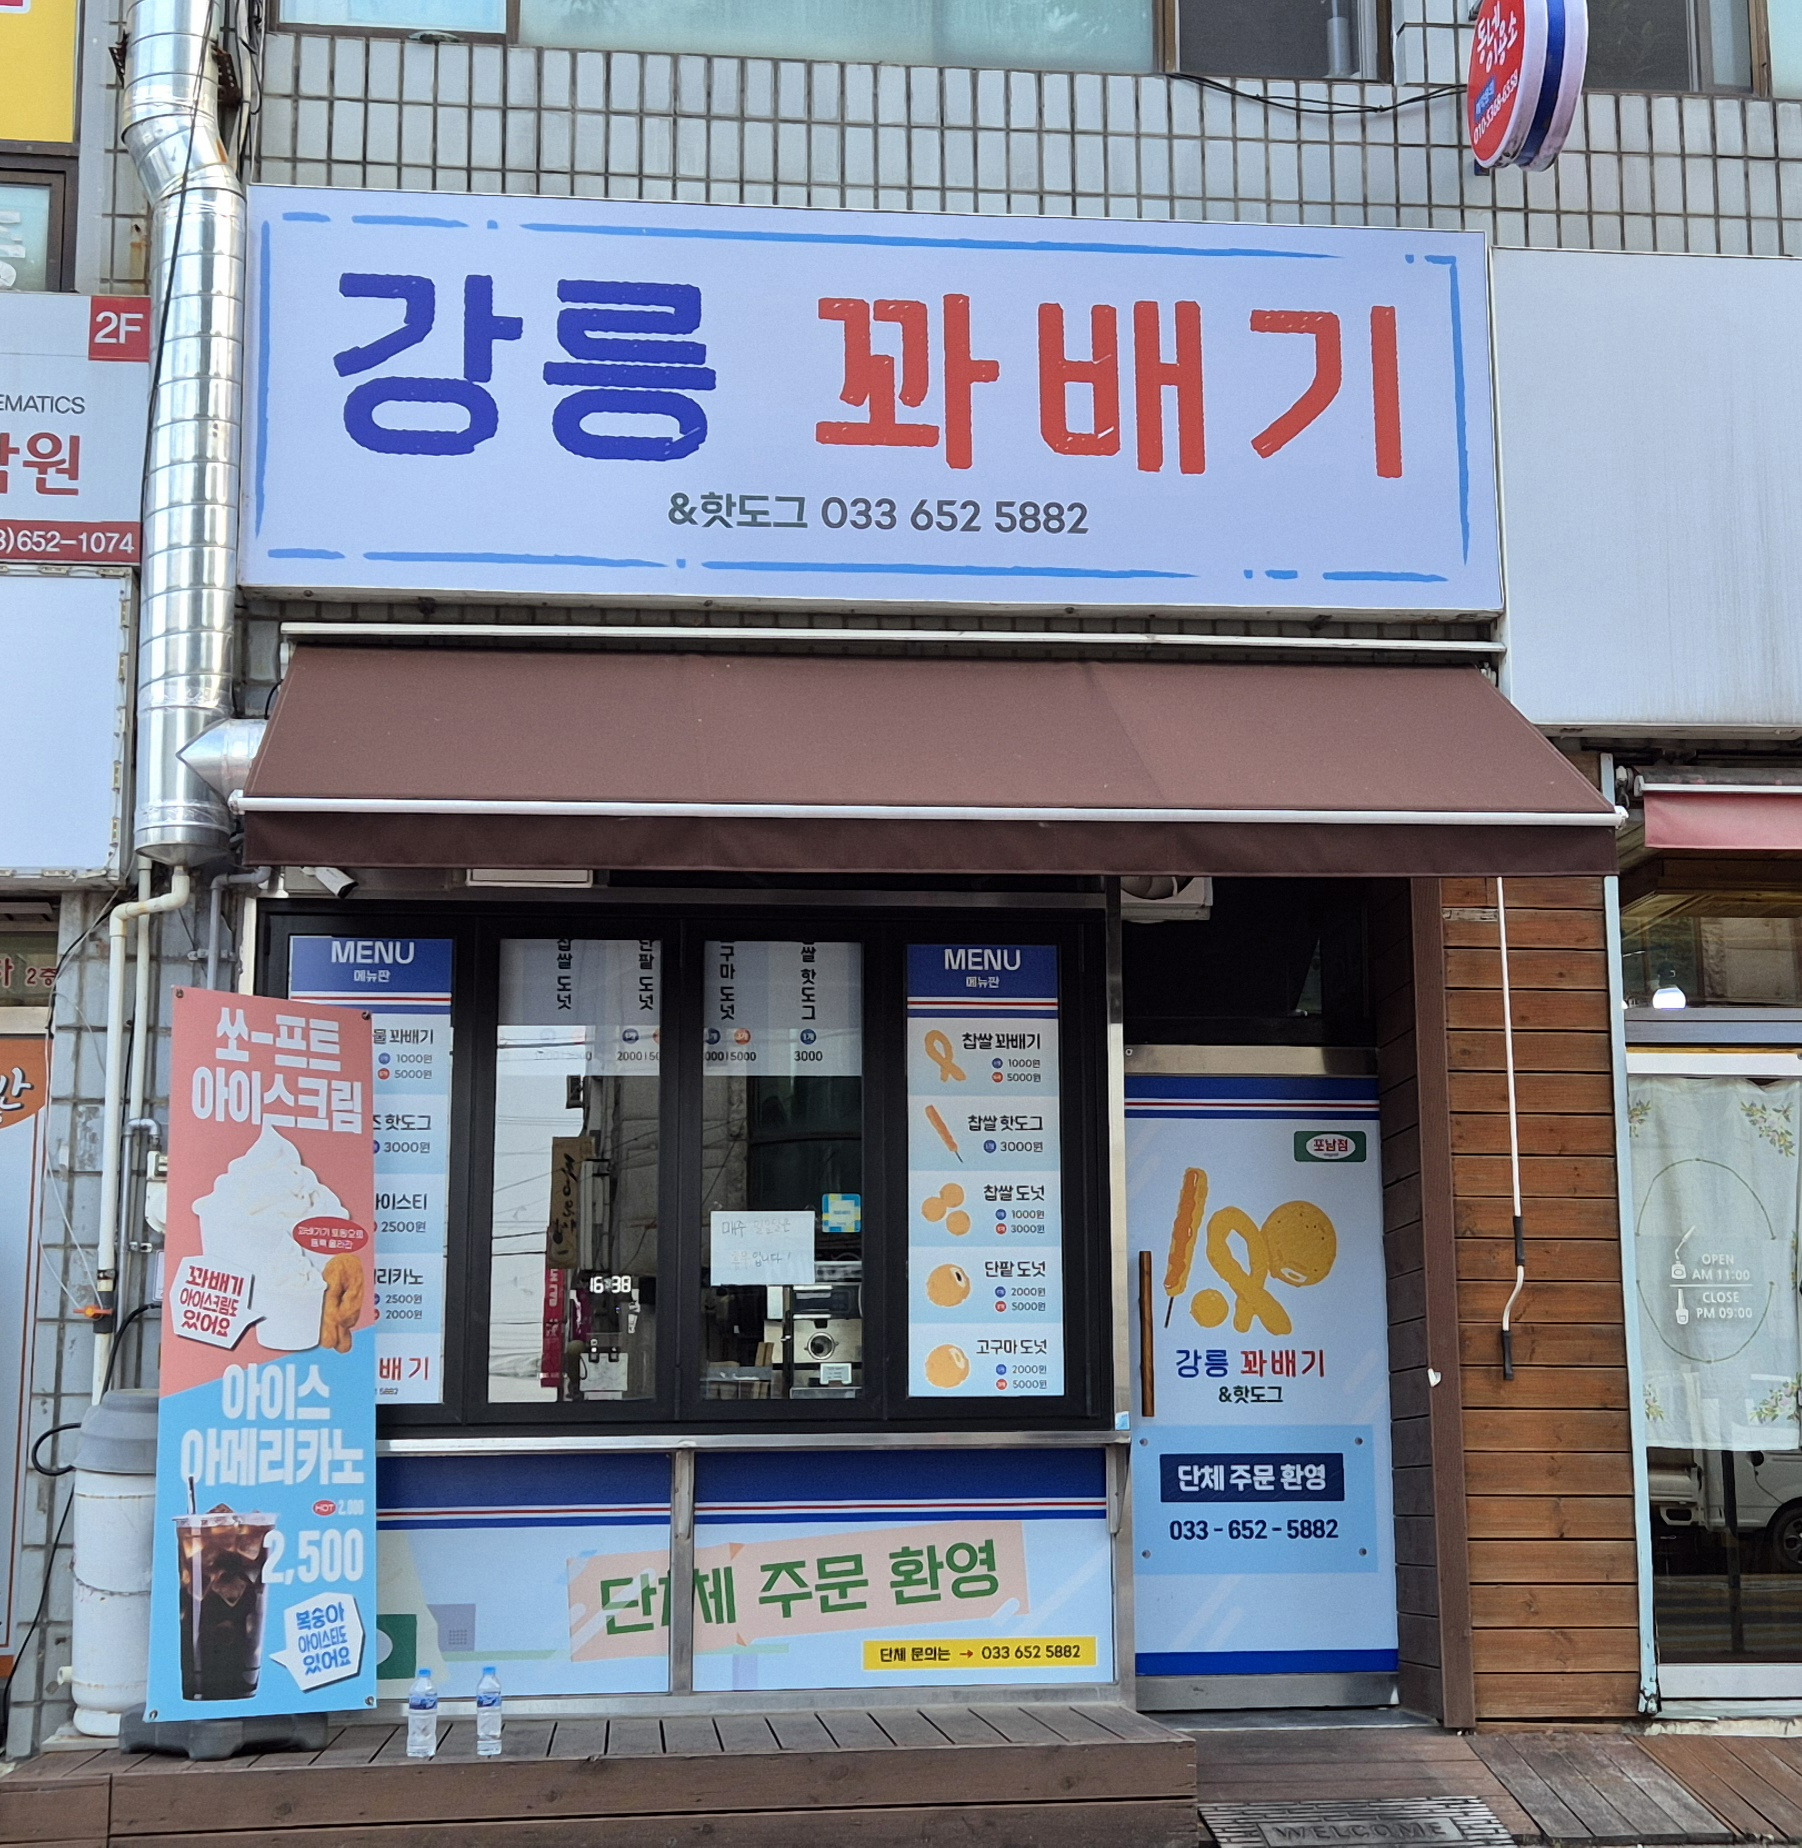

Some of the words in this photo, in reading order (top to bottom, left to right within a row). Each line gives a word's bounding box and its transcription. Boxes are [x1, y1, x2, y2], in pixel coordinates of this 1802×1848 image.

[94, 311, 144, 344] 2F
[333, 272, 716, 462] 강릉
[815, 293, 1403, 479] 꽈배기
[667, 491, 808, 530] &핫도그
[821, 496, 897, 531] 033
[910, 498, 982, 533] 652
[994, 500, 1090, 535] 5882
[331, 940, 415, 965] MENU
[943, 948, 1021, 971] MENU
[353, 969, 391, 983] 메뉴판
[965, 976, 1000, 988] 메뉴판
[389, 1028, 434, 1046] 꽈배기
[962, 1032, 993, 1050] 찹쌀
[995, 1032, 1041, 1050] 꽈배기
[396, 1053, 433, 1064] 1000원
[794, 1050, 823, 1062] 3000
[1007, 1059, 1041, 1069] 1000원
[394, 1069, 432, 1080] 5000원
[1006, 1072, 1041, 1083] 5000원
[191, 1066, 363, 1134] 아이스크림
[385, 1113, 432, 1131] 핫도그
[967, 1114, 998, 1132] 찹쌀
[1000, 1114, 1043, 1132] 핫도그
[384, 1141, 431, 1154] 3000원
[1000, 1141, 1043, 1154] 3000원
[1313, 1138, 1348, 1152] 포남점
[983, 1184, 1014, 1202] 찹쌀
[1016, 1184, 1045, 1202] 도넛
[1011, 1209, 1045, 1220] 1000원
[381, 1221, 427, 1233] 2500원
[1011, 1224, 1045, 1234] 3000원
[1701, 1253, 1735, 1265] OPEN
[984, 1260, 1014, 1278] 단팥
[1017, 1260, 1046, 1278] 도넛
[1692, 1268, 1713, 1280] AM
[1716, 1269, 1750, 1281] 11:00
[185, 1265, 244, 1297] 꽈배기
[385, 1293, 423, 1305] 2500원
[1011, 1287, 1046, 1297] 2000원
[1702, 1291, 1740, 1303] CLOSE
[179, 1287, 240, 1318] 아이스크림도
[1011, 1301, 1046, 1312] 5000원
[385, 1309, 423, 1320] 2000원
[1696, 1307, 1715, 1319] PM
[1719, 1307, 1753, 1319] 09:00
[181, 1309, 230, 1338] 있어요
[976, 1339, 1018, 1355] 고구마
[1020, 1339, 1047, 1355] 도넛
[1012, 1364, 1047, 1375] 2000원
[1176, 1349, 1229, 1378] 강릉
[1240, 1349, 1325, 1378] 꽈배기
[221, 1363, 331, 1421] 아이스
[1013, 1379, 1048, 1390] 5000원
[1218, 1386, 1284, 1404] &핫도그
[180, 1428, 365, 1486] 아메리카노
[1178, 1464, 1225, 1492] 단체
[1229, 1464, 1276, 1491] 주문
[1280, 1463, 1326, 1491] 환영
[315, 1503, 335, 1512] HOT
[261, 1528, 365, 1586] 2,500
[758, 1552, 869, 1621] 주문
[888, 1537, 1001, 1606] 환영
[296, 1601, 345, 1631] 복숭아
[303, 1645, 352, 1676] 있어요
[880, 1647, 906, 1663] 단체
[911, 1646, 951, 1662] 문의는
[981, 1645, 1010, 1660] 033
[1014, 1645, 1041, 1660] 652
[1045, 1644, 1081, 1659] 5882
[1271, 1820, 1448, 1841] WELCOME
